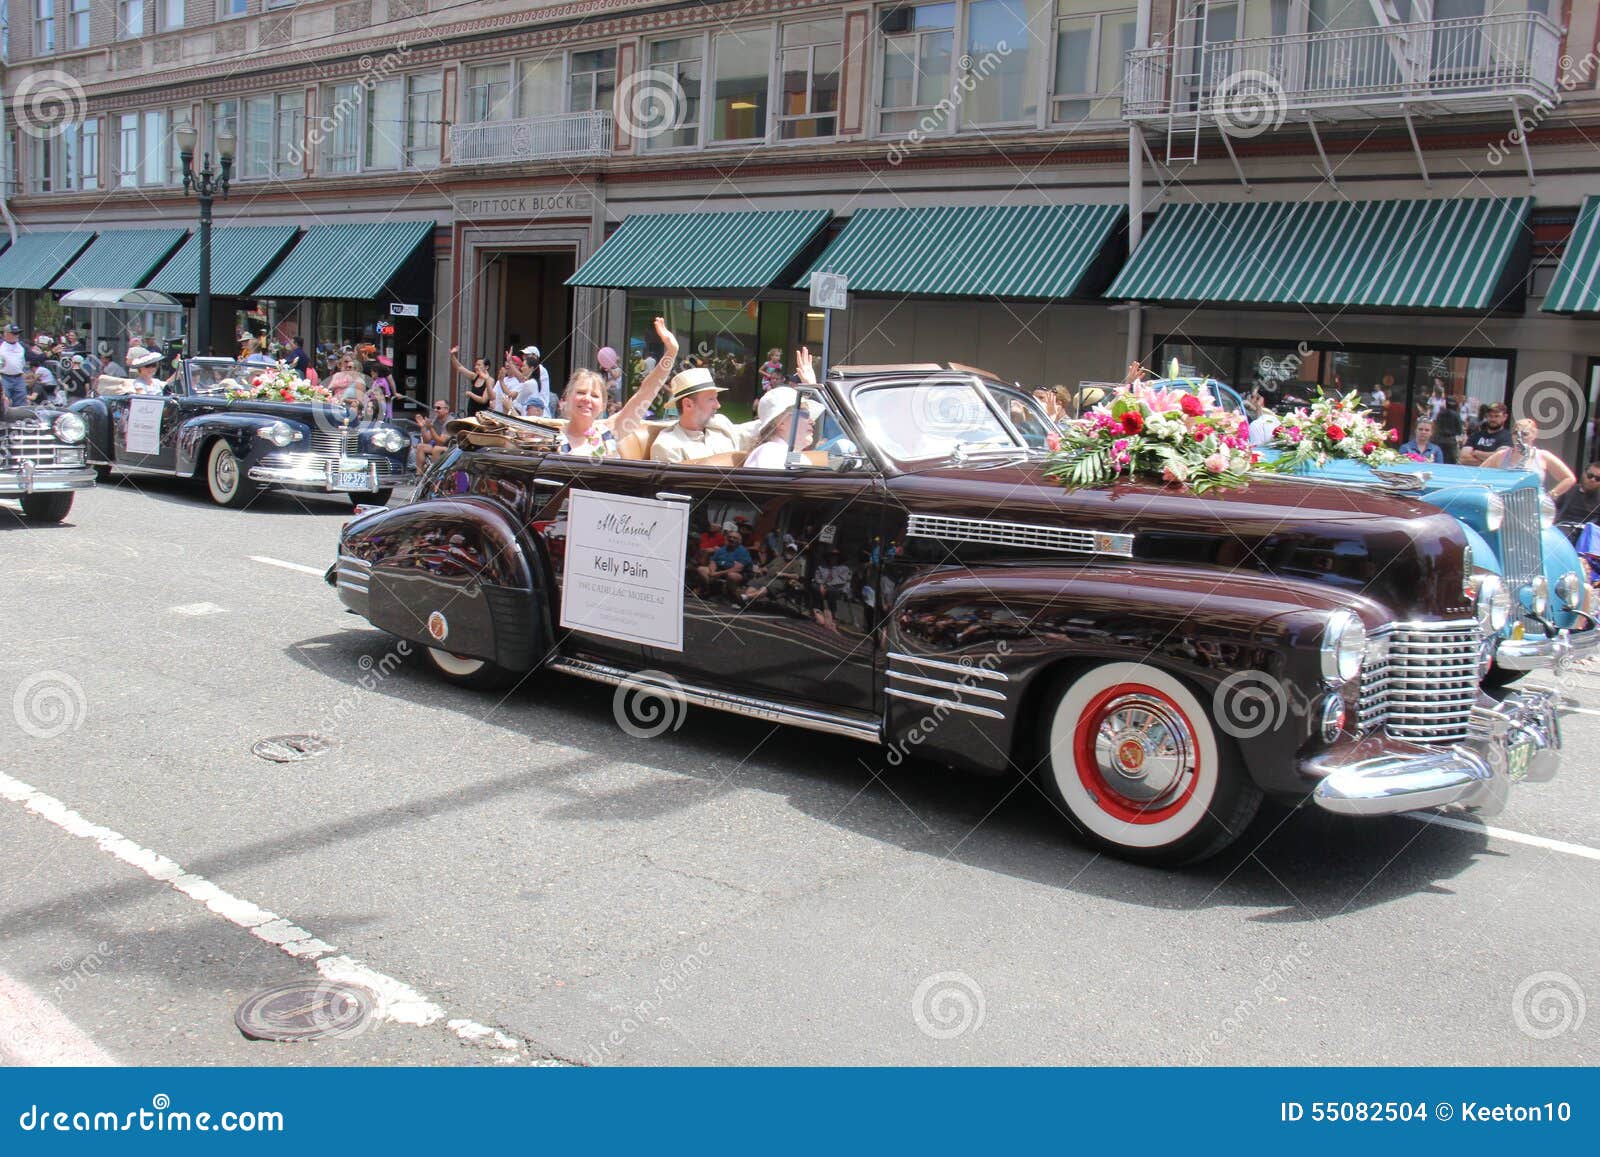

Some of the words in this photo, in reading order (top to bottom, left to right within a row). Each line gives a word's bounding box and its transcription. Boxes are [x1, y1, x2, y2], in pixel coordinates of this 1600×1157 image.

[472, 199, 526, 213] PITTOCK
[533, 194, 576, 210] BLOCK
[594, 556, 619, 577] Kelly
[622, 560, 649, 579] Palin
